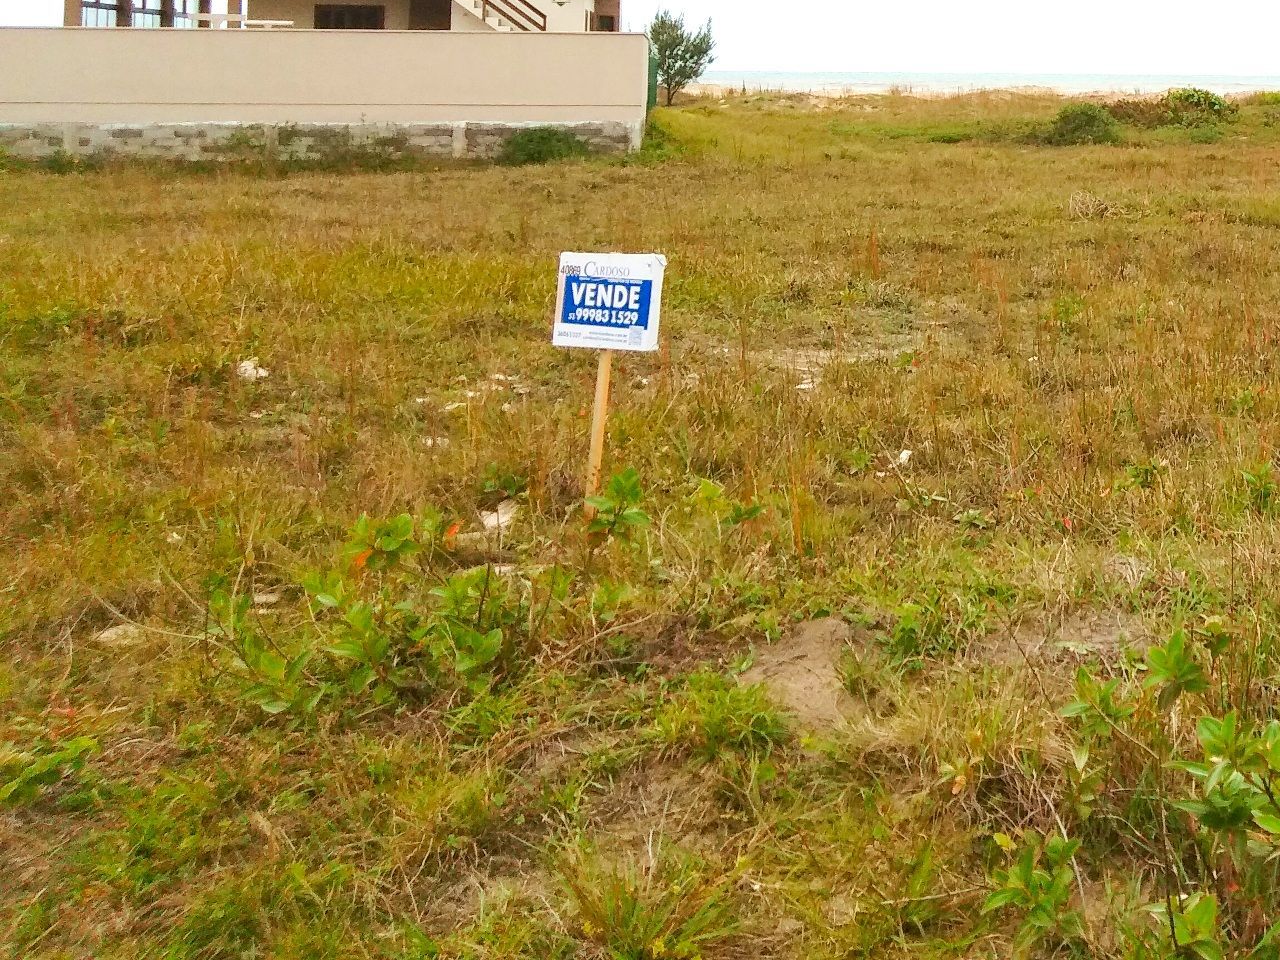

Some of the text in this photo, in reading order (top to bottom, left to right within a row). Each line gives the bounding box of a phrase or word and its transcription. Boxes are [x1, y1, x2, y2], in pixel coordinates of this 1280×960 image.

[584, 261, 630, 277] CARDOSO
[571, 282, 641, 309] VENDE
[575, 307, 609, 323] 99983
[610, 310, 639, 325] 1529
